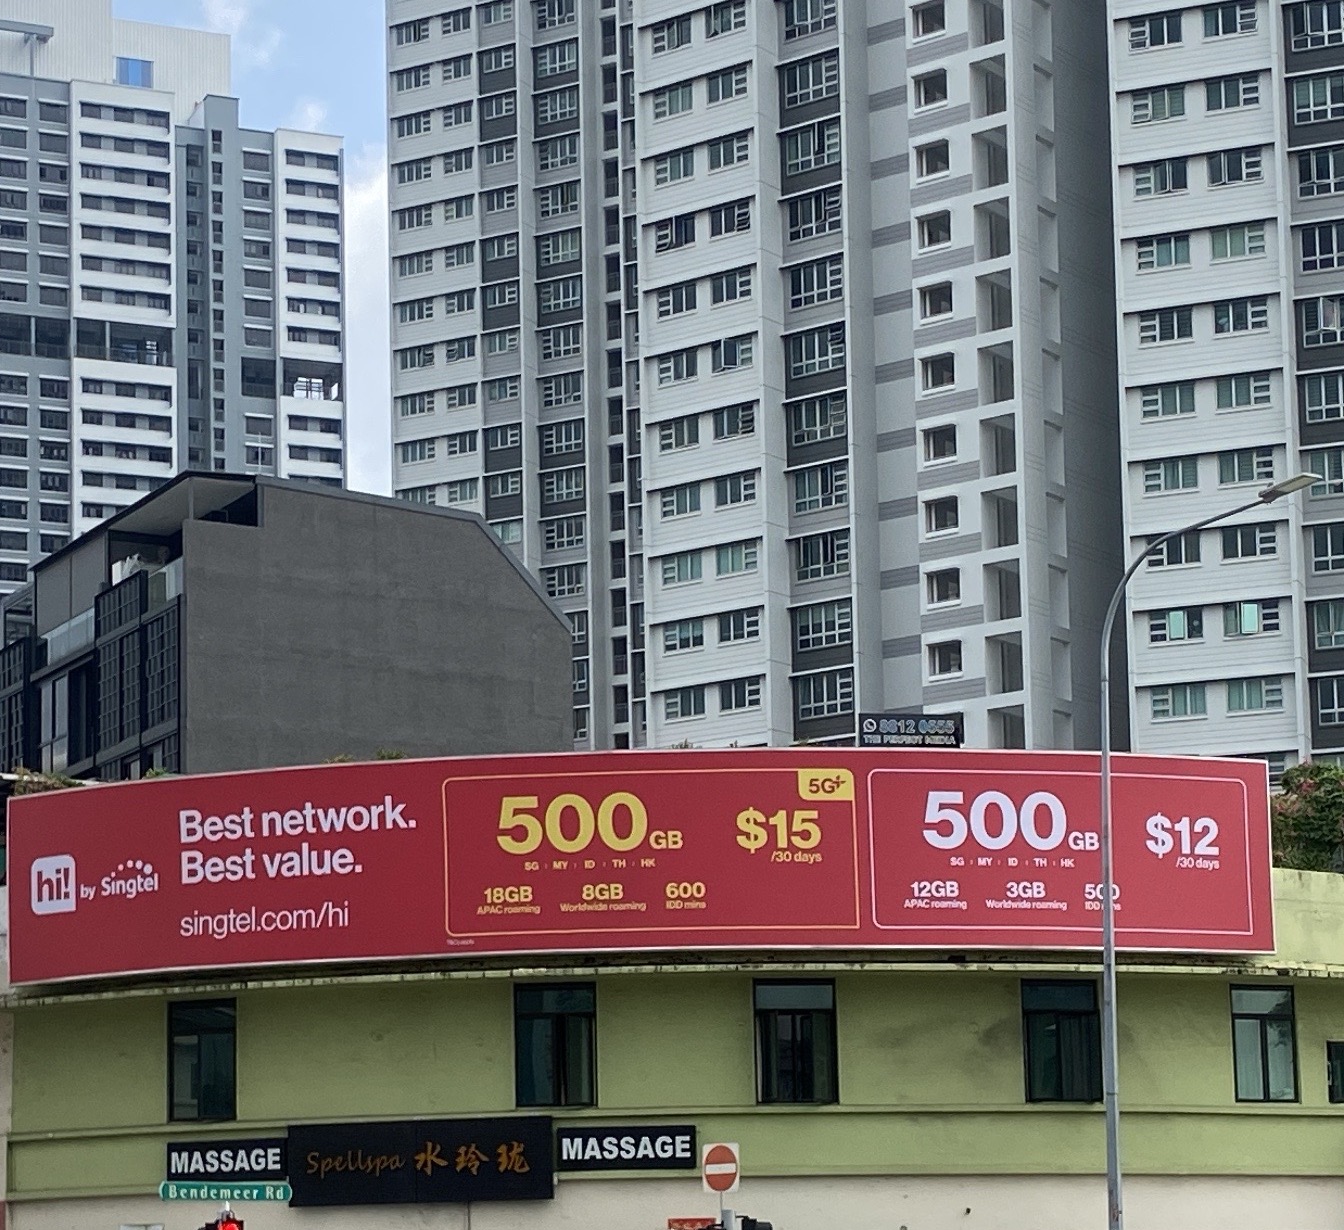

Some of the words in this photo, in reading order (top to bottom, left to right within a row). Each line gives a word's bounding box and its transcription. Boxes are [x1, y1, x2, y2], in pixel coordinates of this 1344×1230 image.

[179, 806, 255, 844] Best
[262, 795, 416, 837] network.
[736, 806, 822, 854] $15
[1146, 812, 1220, 859] $12
[181, 848, 256, 884] Best
[262, 842, 363, 878] value.
[524, 861, 540, 871] SG
[553, 861, 569, 870] MY
[612, 859, 627, 868] TH
[641, 858, 656, 867] HK
[770, 851, 792, 863] /30
[794, 850, 823, 864] days
[950, 857, 965, 867] SG
[977, 857, 993, 867] MY
[1034, 857, 1048, 867] TH
[1060, 858, 1075, 868] HK
[1176, 856, 1195, 868] /30
[1196, 858, 1220, 871] days
[36, 867, 71, 903] hi!
[80, 884, 96, 901] by
[100, 872, 159, 899] Singtel
[581, 883, 624, 900] 8GB
[665, 882, 706, 899] 600
[910, 880, 960, 898] 12GB
[1005, 881, 1046, 898] 3GB
[484, 886, 533, 904] 18GB
[476, 905, 504, 915] APAC
[504, 905, 541, 915] roaming
[559, 903, 609, 913] Worldwide
[609, 901, 647, 912] roaming
[904, 899, 931, 909] APAC
[931, 901, 968, 911] roaming
[985, 899, 1031, 909] Worldwide
[1032, 901, 1068, 912] roaming
[180, 900, 349, 940] singtel.com/hi
[561, 1135, 692, 1160] MASSAGE
[170, 1147, 282, 1174] MASSAGE
[306, 1150, 406, 1179] Spellspa
[168, 1184, 259, 1200] Bendemeer
[265, 1185, 284, 1200] Rd
